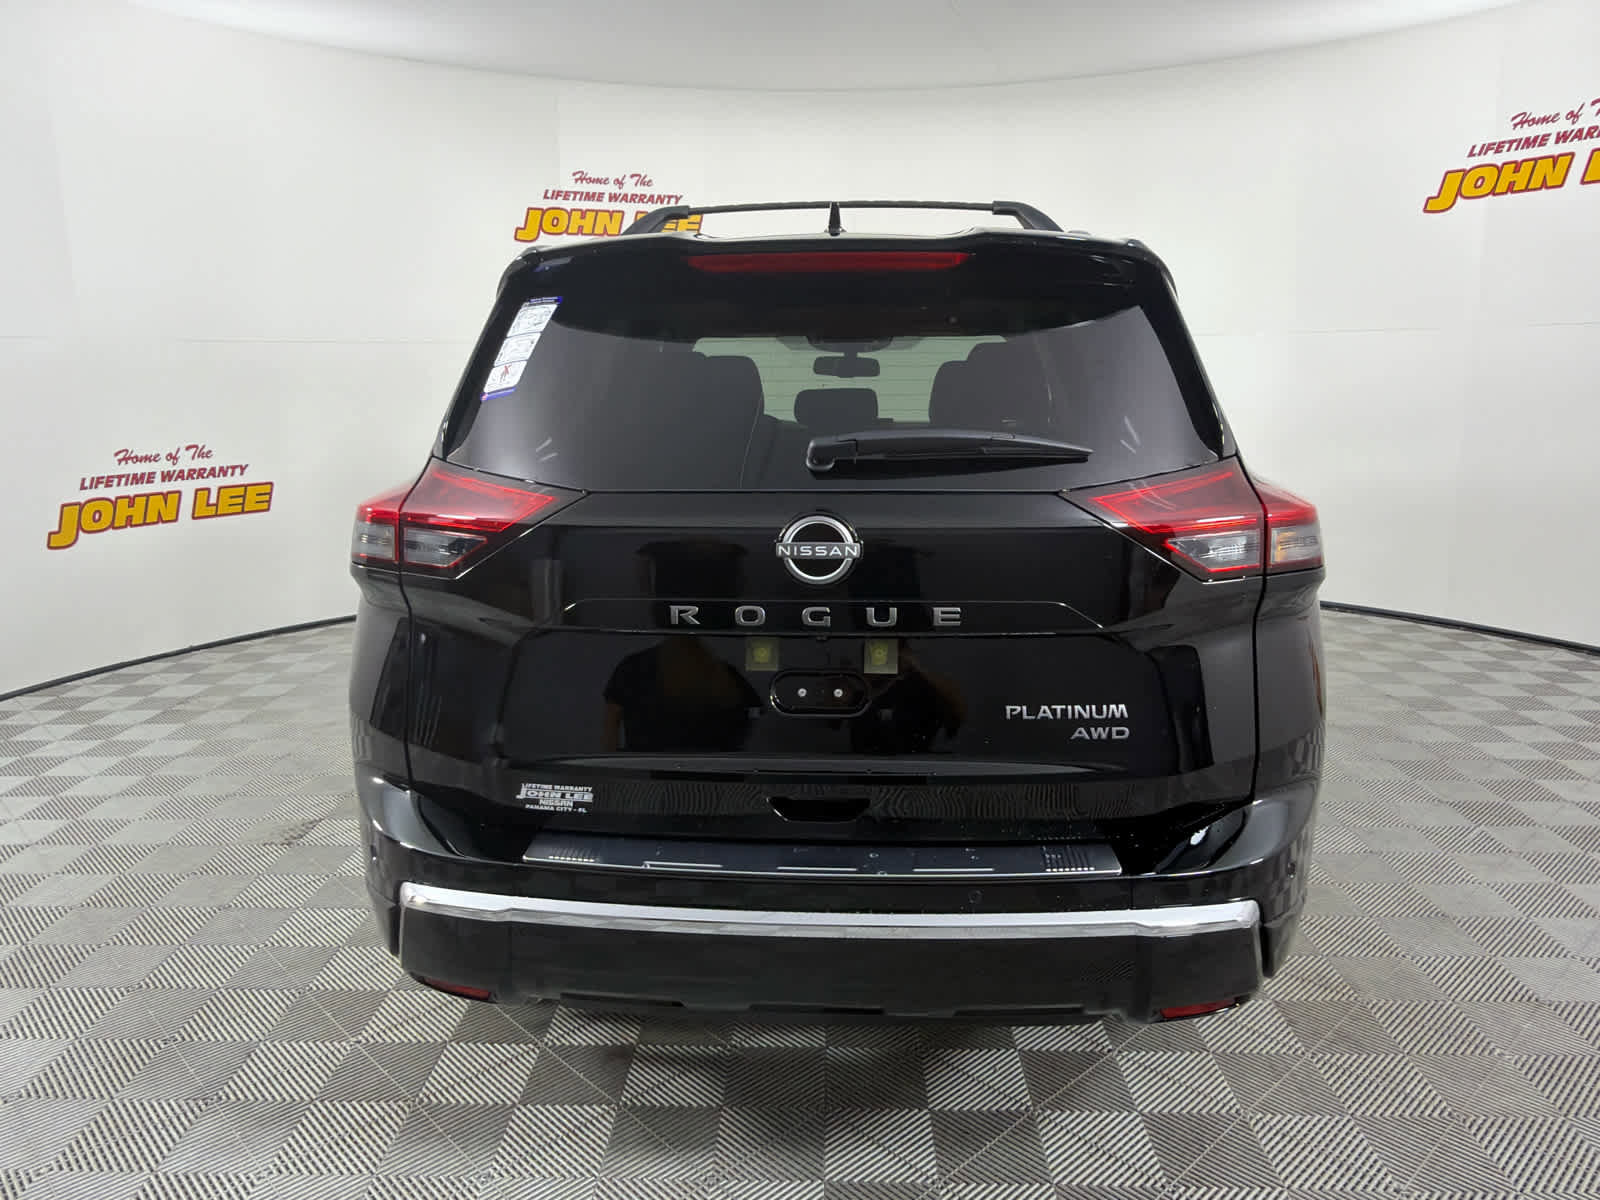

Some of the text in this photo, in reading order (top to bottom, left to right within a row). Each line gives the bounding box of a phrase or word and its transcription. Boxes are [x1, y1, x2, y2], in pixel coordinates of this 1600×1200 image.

[1510, 111, 1560, 130] Home
[1565, 102, 1586, 125] of
[1467, 124, 1600, 158] LIFETIME WAR
[571, 170, 653, 189] Home of The
[1423, 151, 1576, 213] JOHN
[543, 188, 683, 205] LIFETIME WARRANTY
[514, 207, 624, 243] JOHN
[113, 444, 214, 466] Home of The
[79, 463, 249, 491] LIFETIME WARRANTY
[47, 481, 274, 550] JOHN LEE
[777, 544, 860, 557] NISSAN
[669, 604, 961, 627] ROGUE
[1005, 704, 1128, 720] PLATINUM
[1070, 726, 1130, 740] AWD
[516, 788, 594, 802] JOHN LEE
[539, 799, 574, 807] NISSAN
